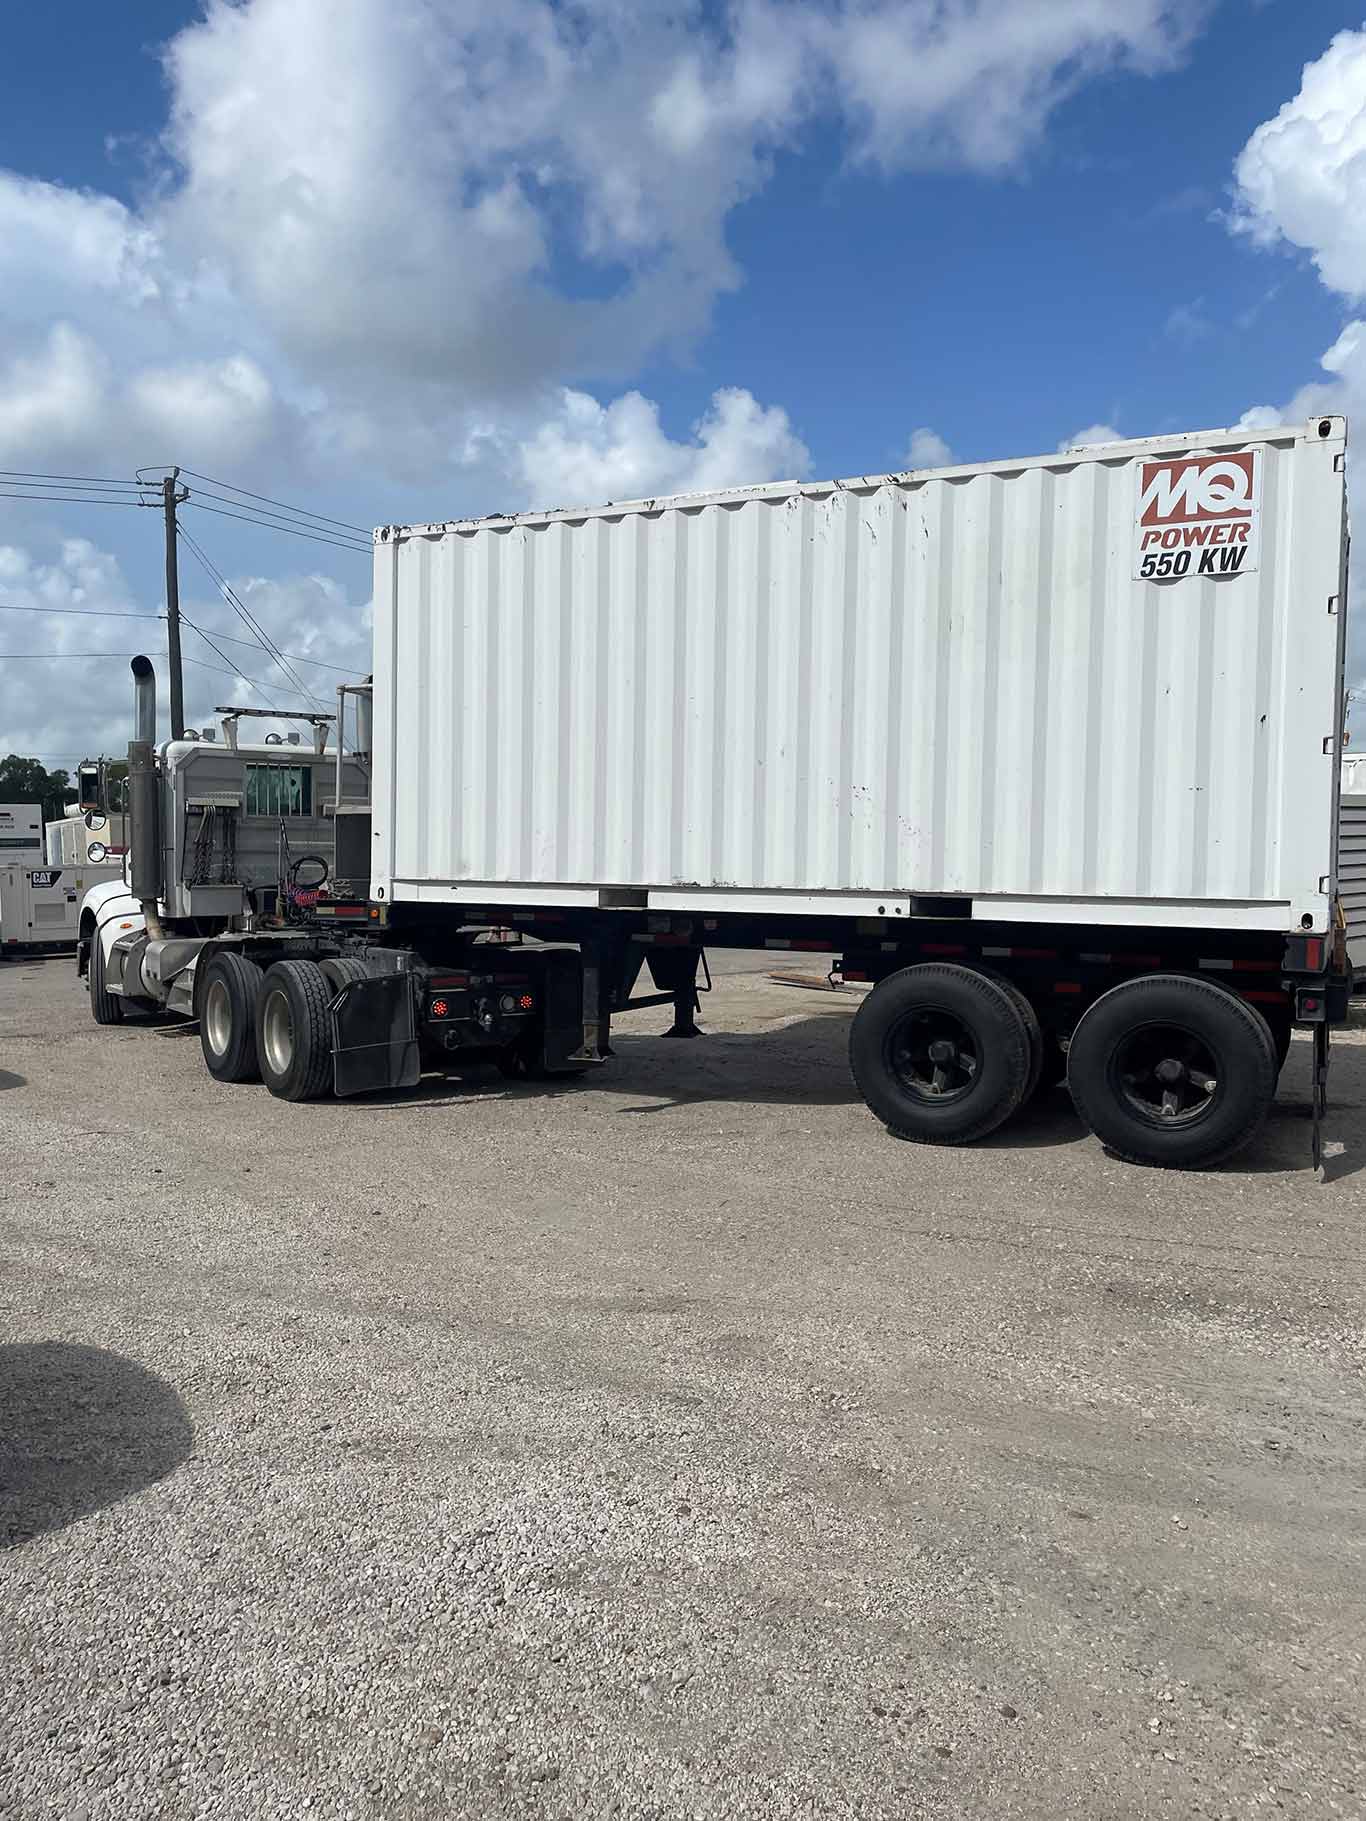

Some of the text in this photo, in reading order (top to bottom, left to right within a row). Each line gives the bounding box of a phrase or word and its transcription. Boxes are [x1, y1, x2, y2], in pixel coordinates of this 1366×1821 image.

[1140, 460, 1253, 518] MQ
[1140, 522, 1251, 551] POWER
[1140, 545, 1248, 577] 550 KW
[32, 872, 52, 884] CAT
